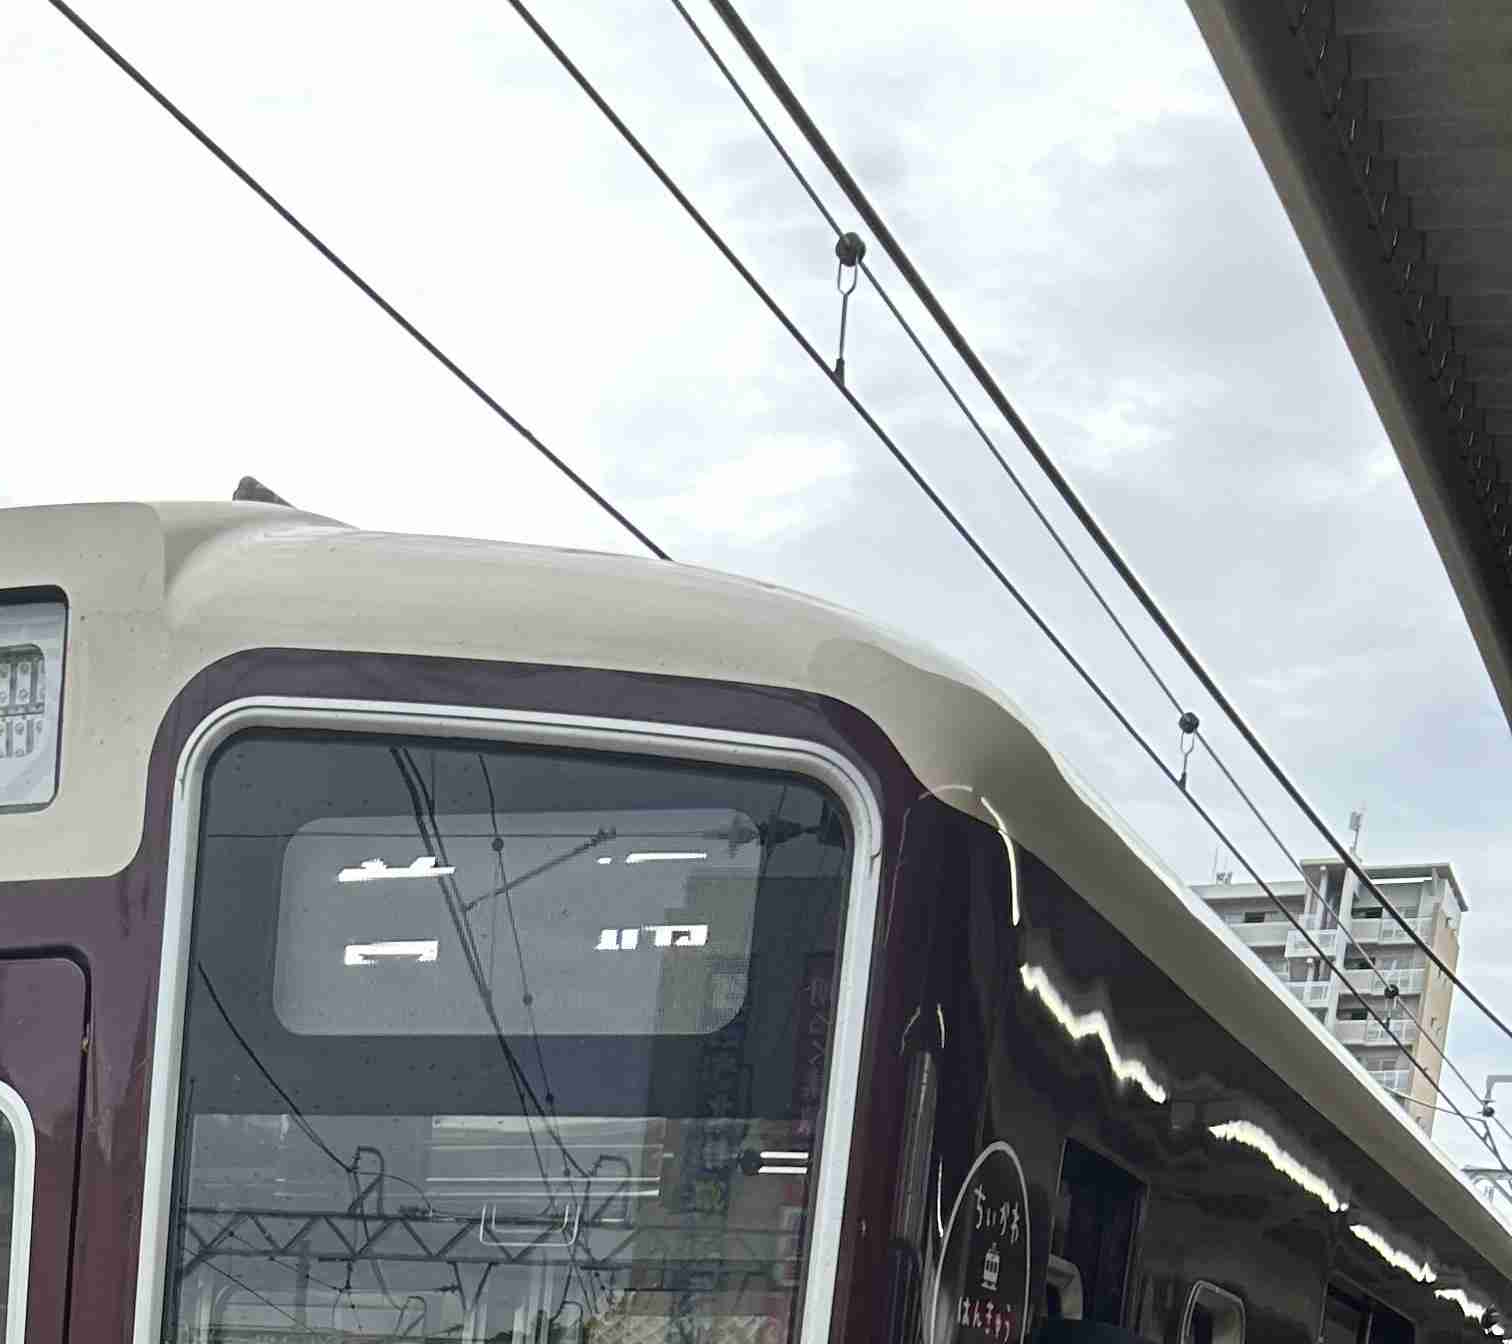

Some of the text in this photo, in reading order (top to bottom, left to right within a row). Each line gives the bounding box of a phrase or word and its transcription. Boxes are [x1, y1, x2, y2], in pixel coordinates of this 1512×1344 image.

[974, 1184, 1019, 1244] ちいかわ
[957, 1296, 1011, 1344] はんきゅう
